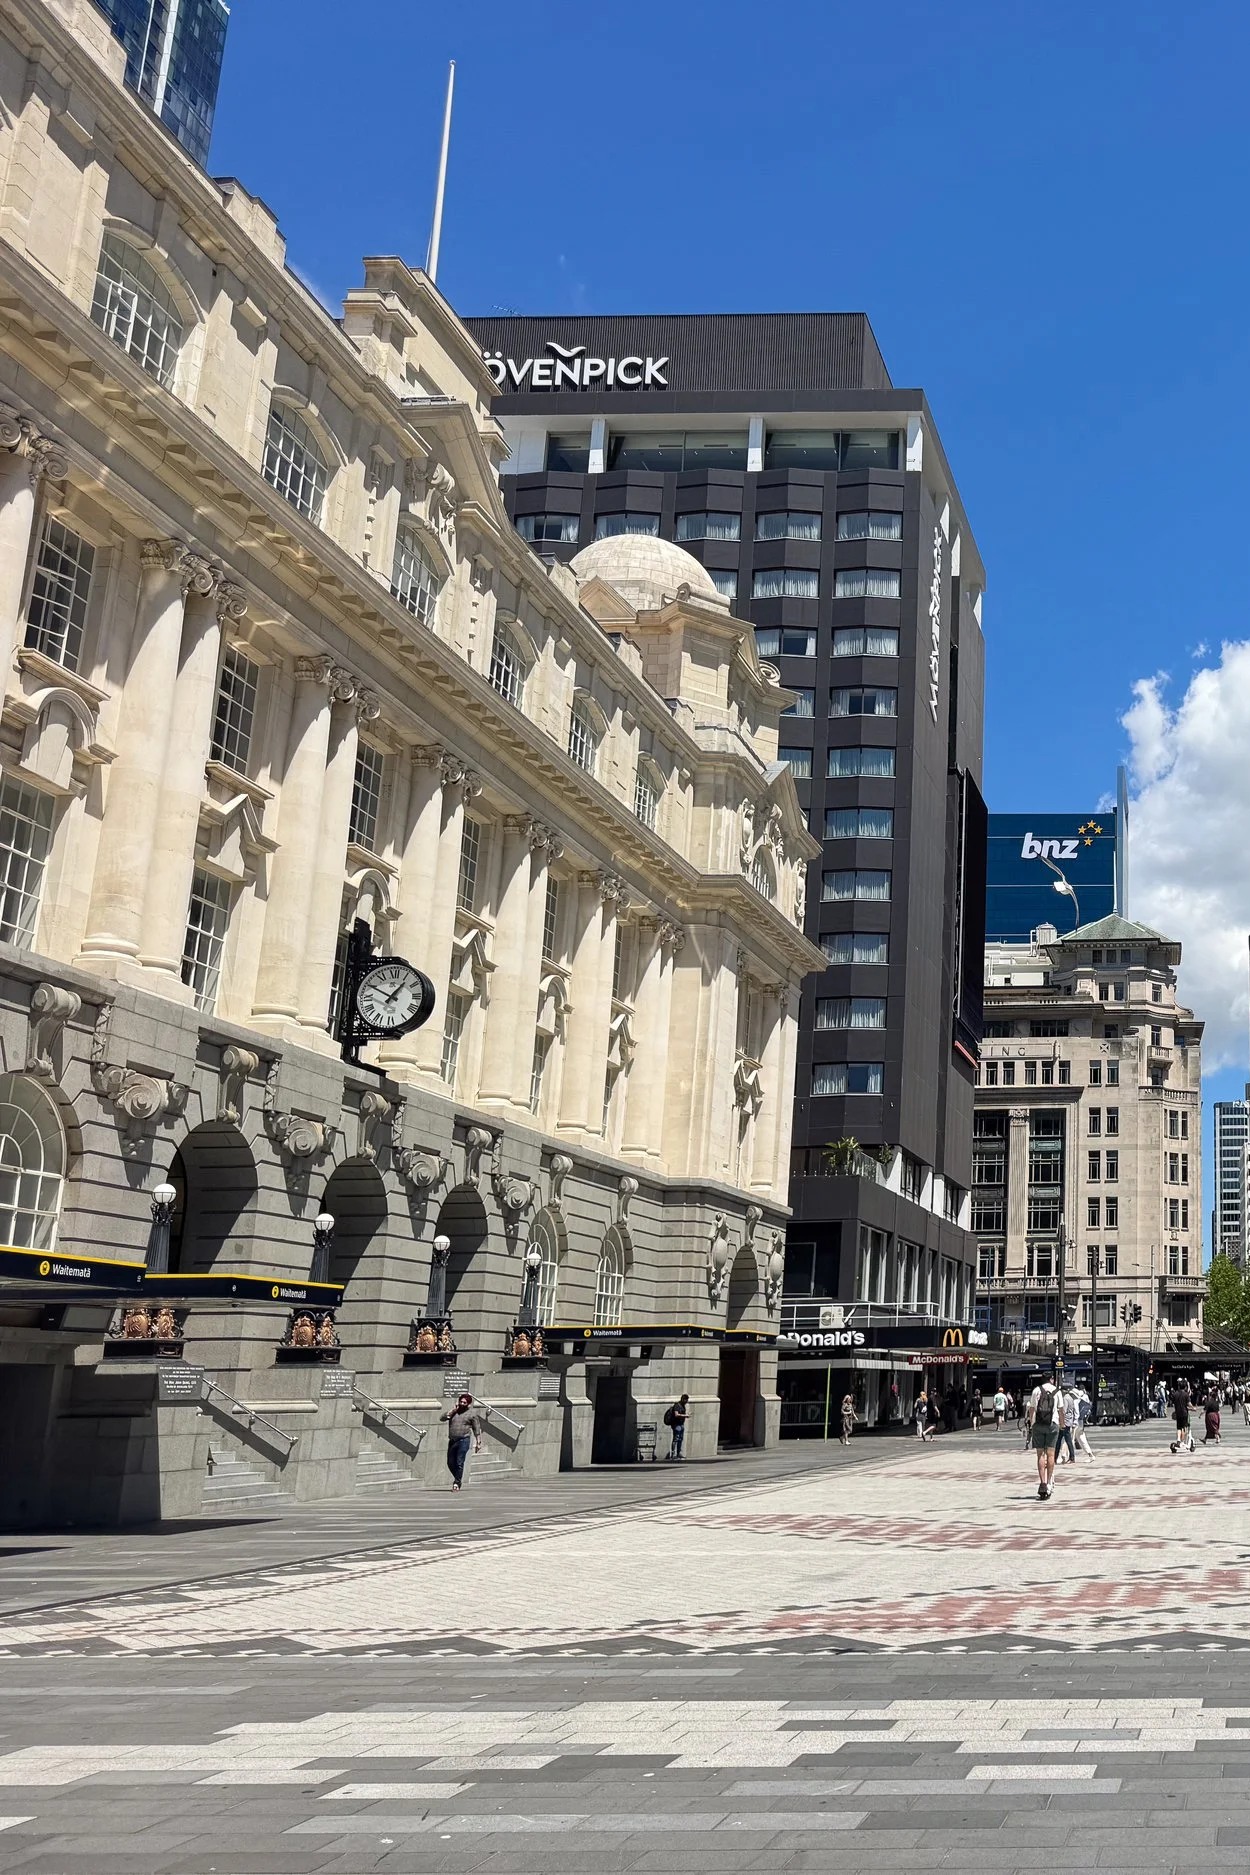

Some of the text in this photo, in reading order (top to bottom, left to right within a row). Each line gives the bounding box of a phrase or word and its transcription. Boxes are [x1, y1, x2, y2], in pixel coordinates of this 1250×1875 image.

[483, 351, 669, 386] ÖVENPICK
[1021, 832, 1080, 859] bnz
[52, 1263, 92, 1278] Waitematā
[776, 1331, 865, 1347] Donald's
[912, 1355, 964, 1364] McDonald's
